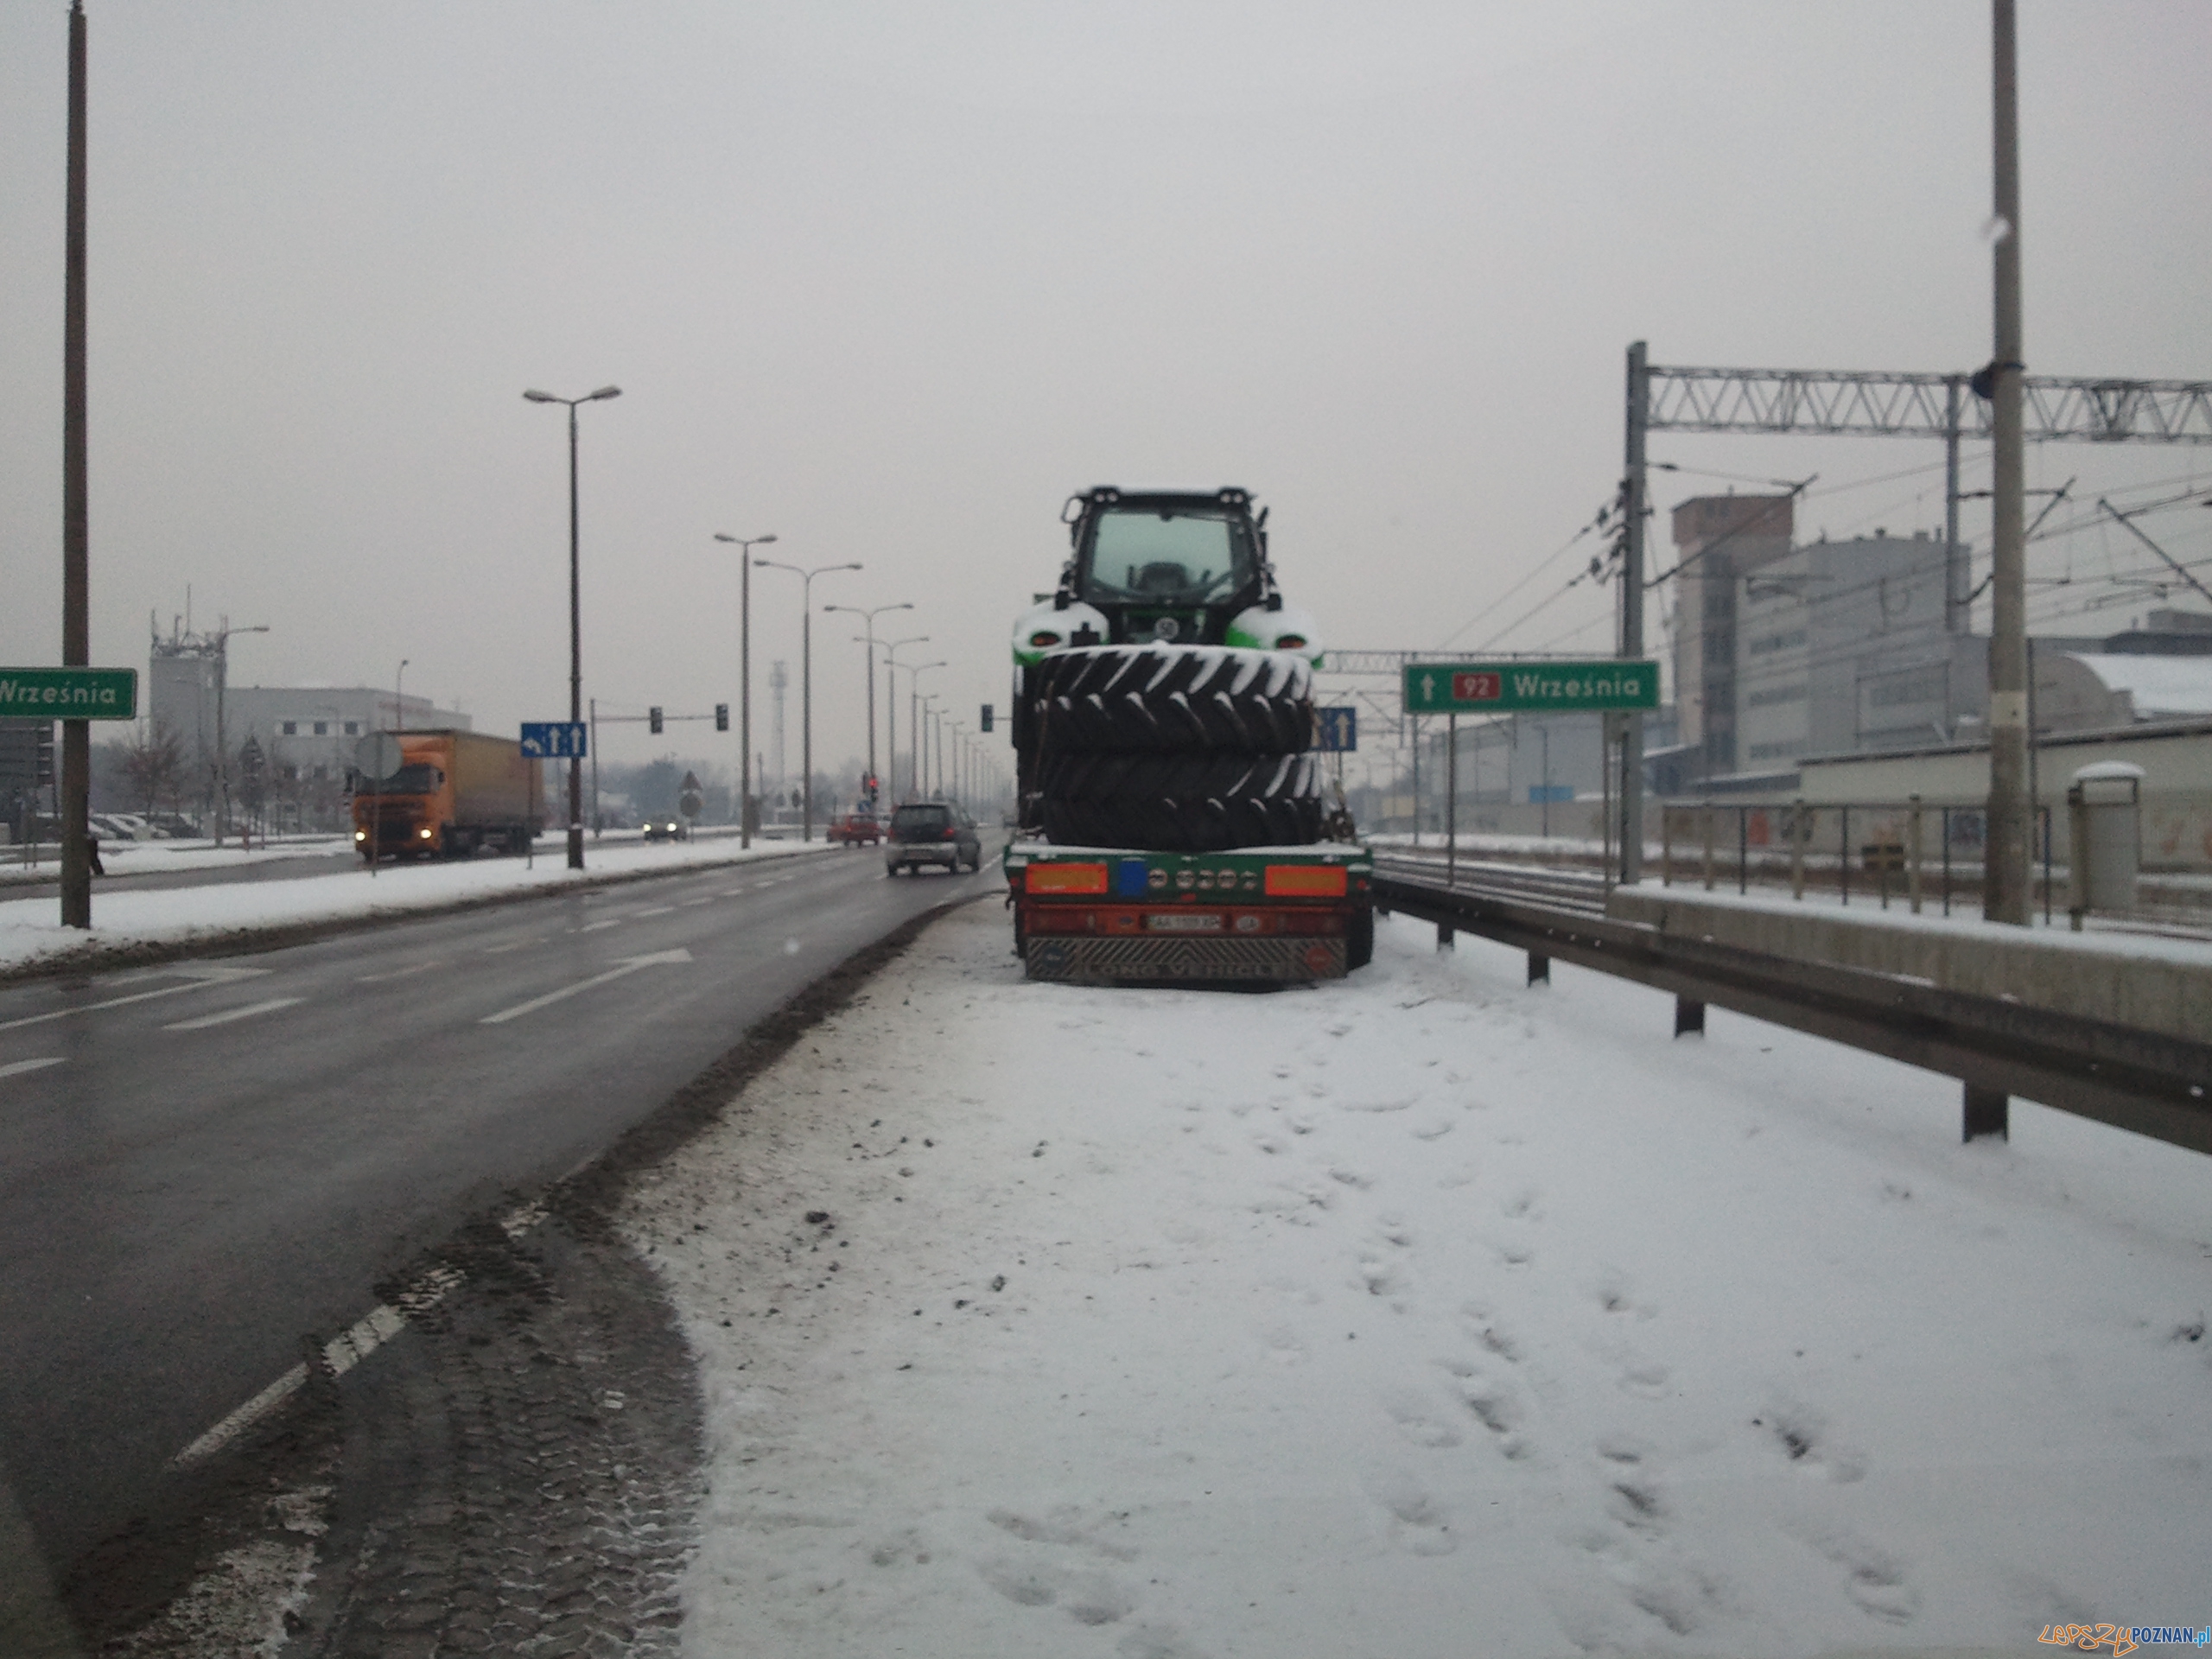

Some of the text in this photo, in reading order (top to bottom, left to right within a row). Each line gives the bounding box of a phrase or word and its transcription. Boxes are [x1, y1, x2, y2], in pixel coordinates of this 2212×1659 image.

[1463, 672, 1640, 697] 92 Września
[1087, 963, 1288, 978] LONG VEHICLE
